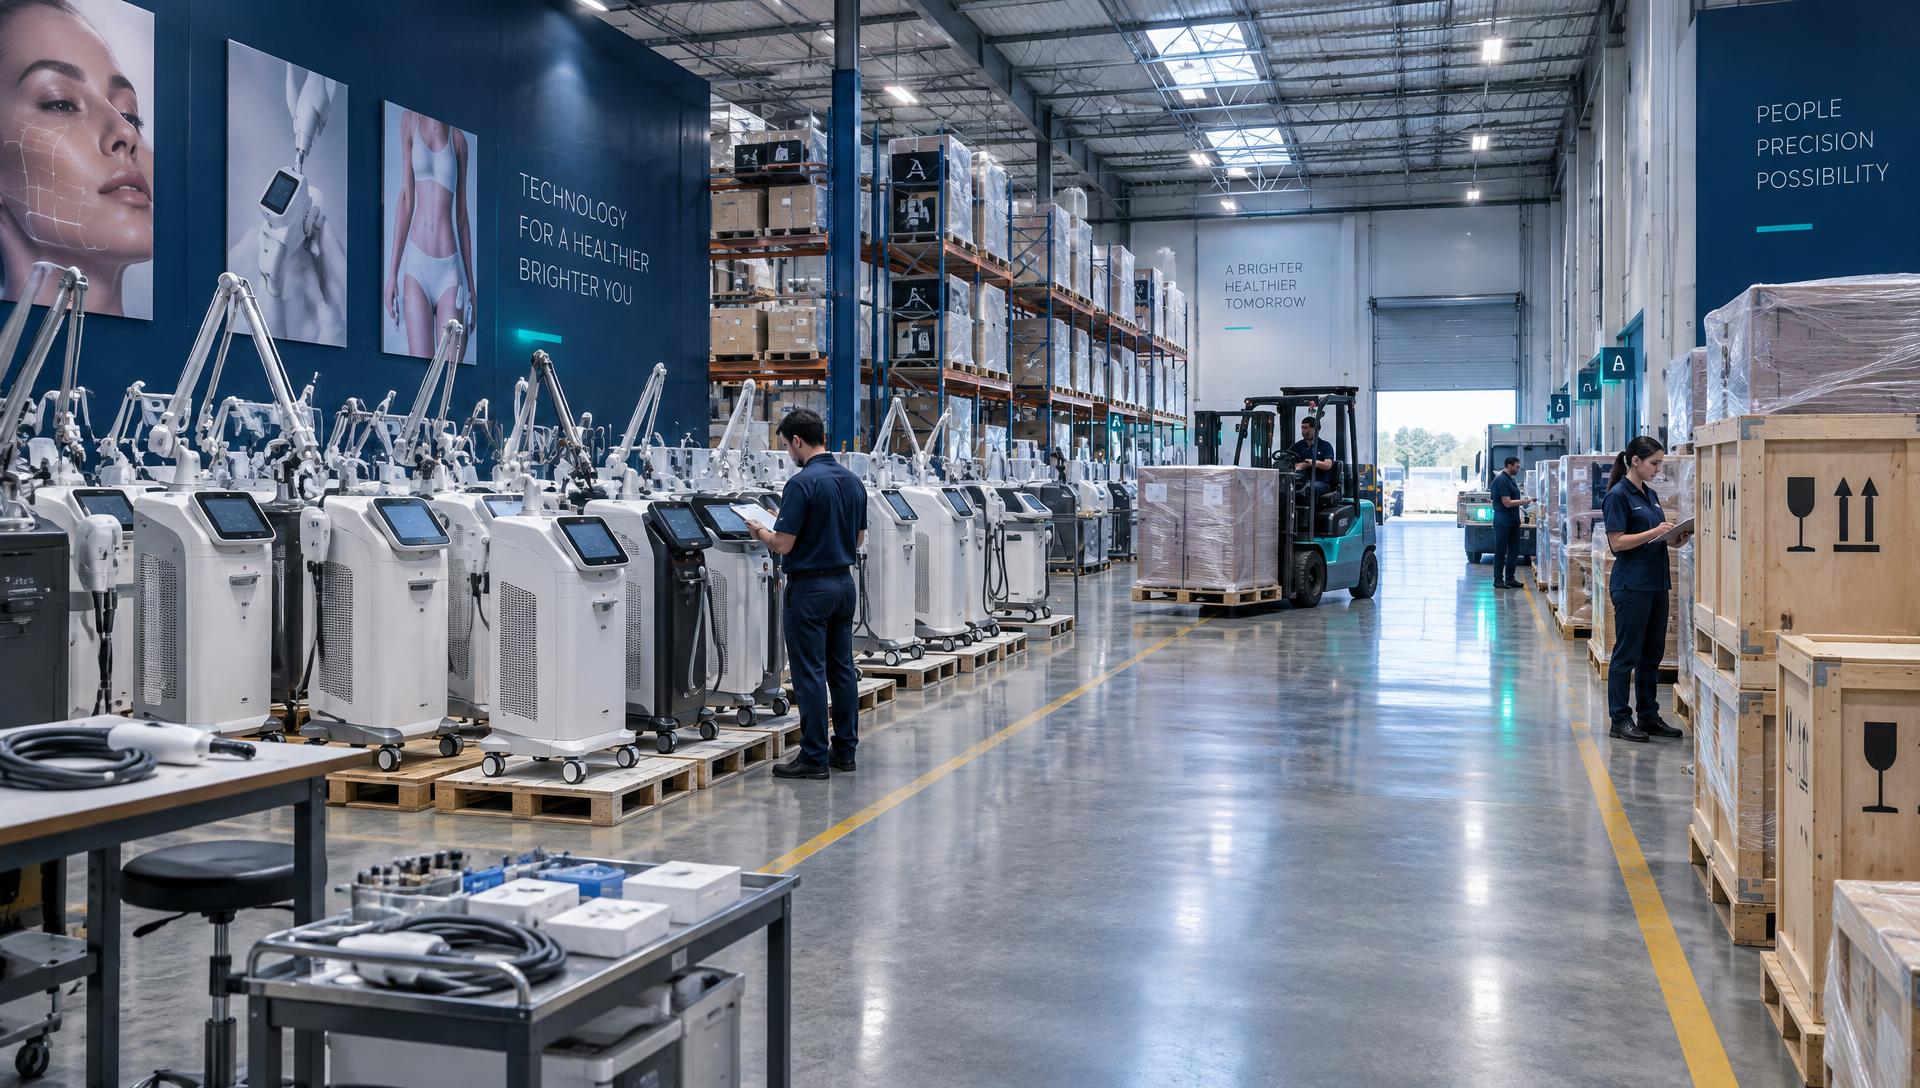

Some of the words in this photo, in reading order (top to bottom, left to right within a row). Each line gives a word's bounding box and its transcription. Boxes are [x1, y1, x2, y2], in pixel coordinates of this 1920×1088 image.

[1757, 98, 1842, 124] PEOPLE
[1757, 130, 1874, 157] PRECISION
[1757, 162, 1889, 191] POSSIBILITY
[519, 172, 627, 230] TECHNOLOGY
[519, 215, 553, 247] FOR
[558, 227, 569, 251] A
[573, 231, 649, 274] HEALTHIER
[519, 257, 599, 298] BRIGHTER
[603, 278, 632, 305] YOU
[1225, 264, 1234, 275] A
[1238, 262, 1303, 275] BRIGHTER
[1225, 279, 1297, 293] HEALTHIER
[1225, 296, 1306, 310] TOMORROW
[1612, 354, 1625, 372] A
